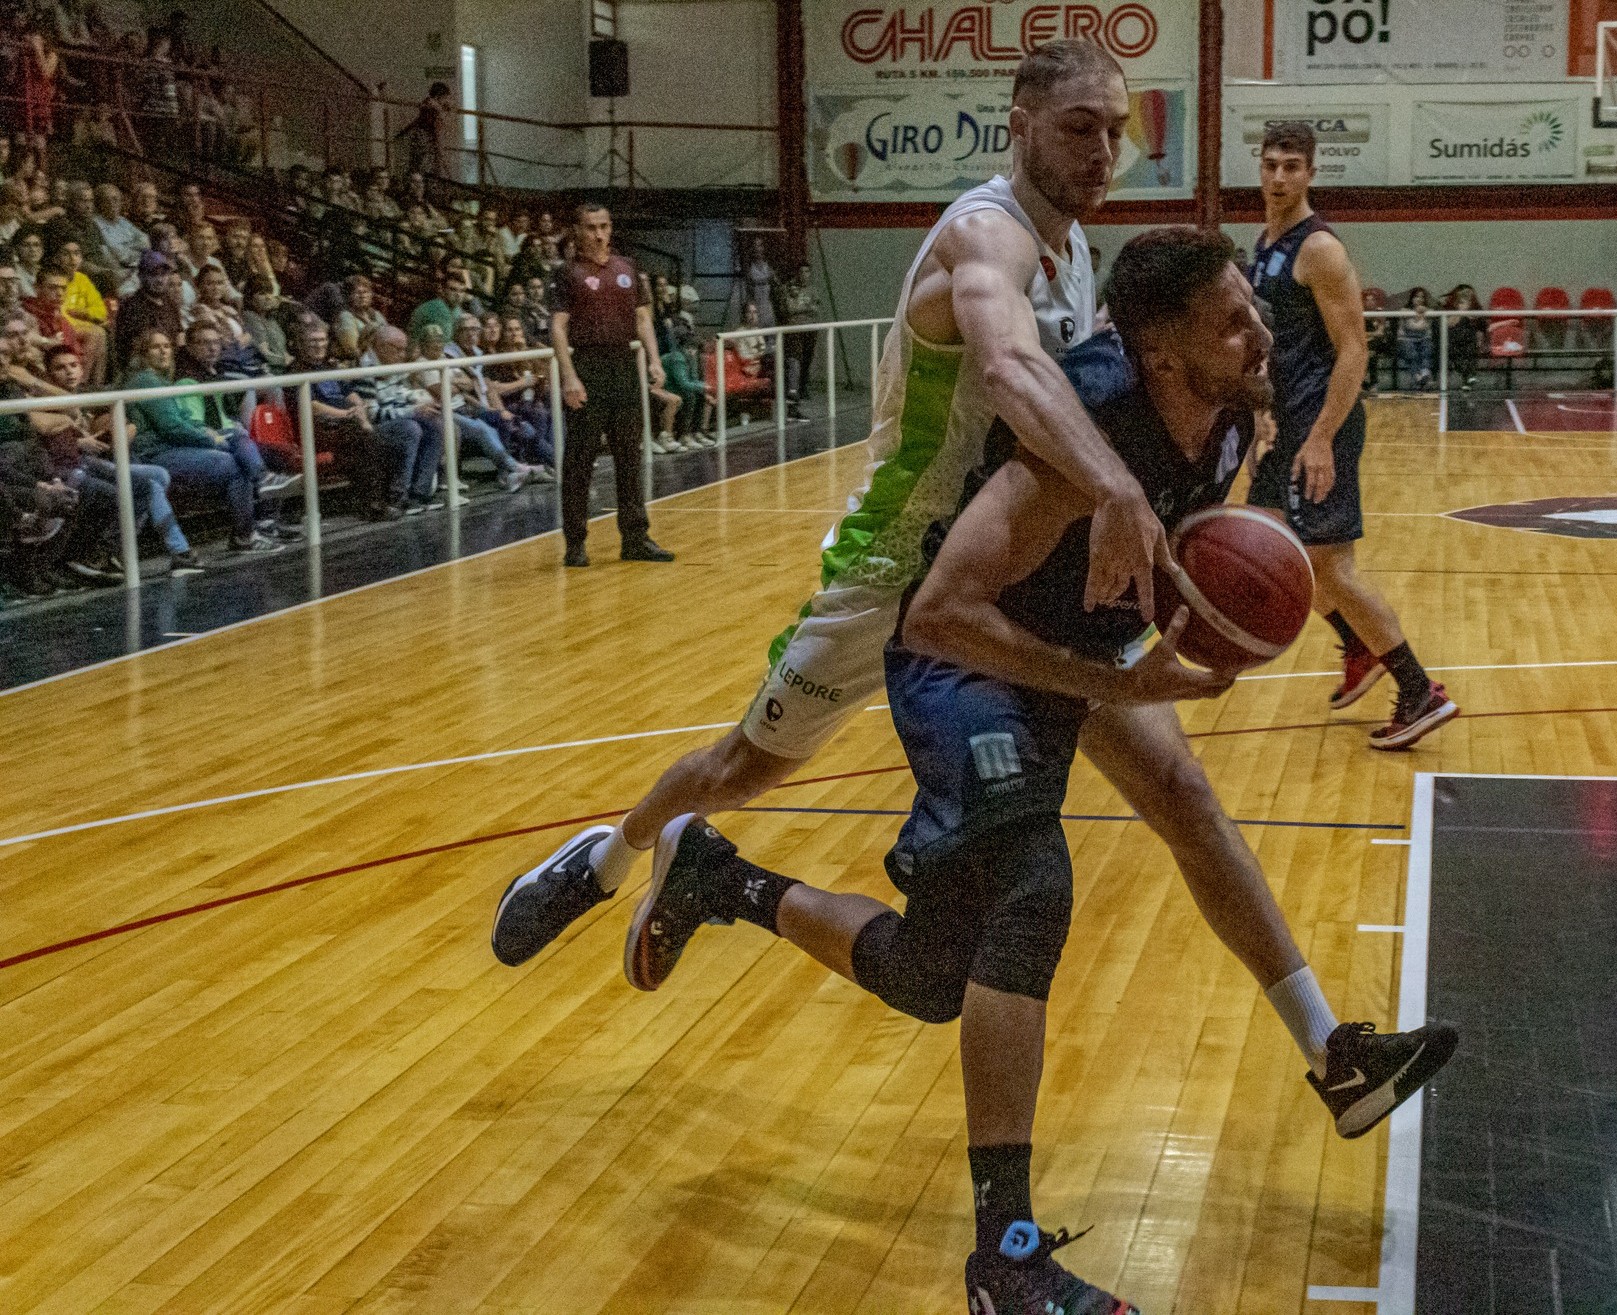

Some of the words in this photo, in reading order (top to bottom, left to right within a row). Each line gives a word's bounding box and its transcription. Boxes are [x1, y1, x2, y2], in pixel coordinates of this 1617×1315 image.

[841, 3, 1158, 64] CHALERO
[1307, 0, 1390, 56] po!
[866, 111, 944, 161] GIRO
[1319, 147, 1361, 157] VOLVO
[1429, 138, 1531, 159] Sumidás
[779, 662, 843, 702] LEPORE
